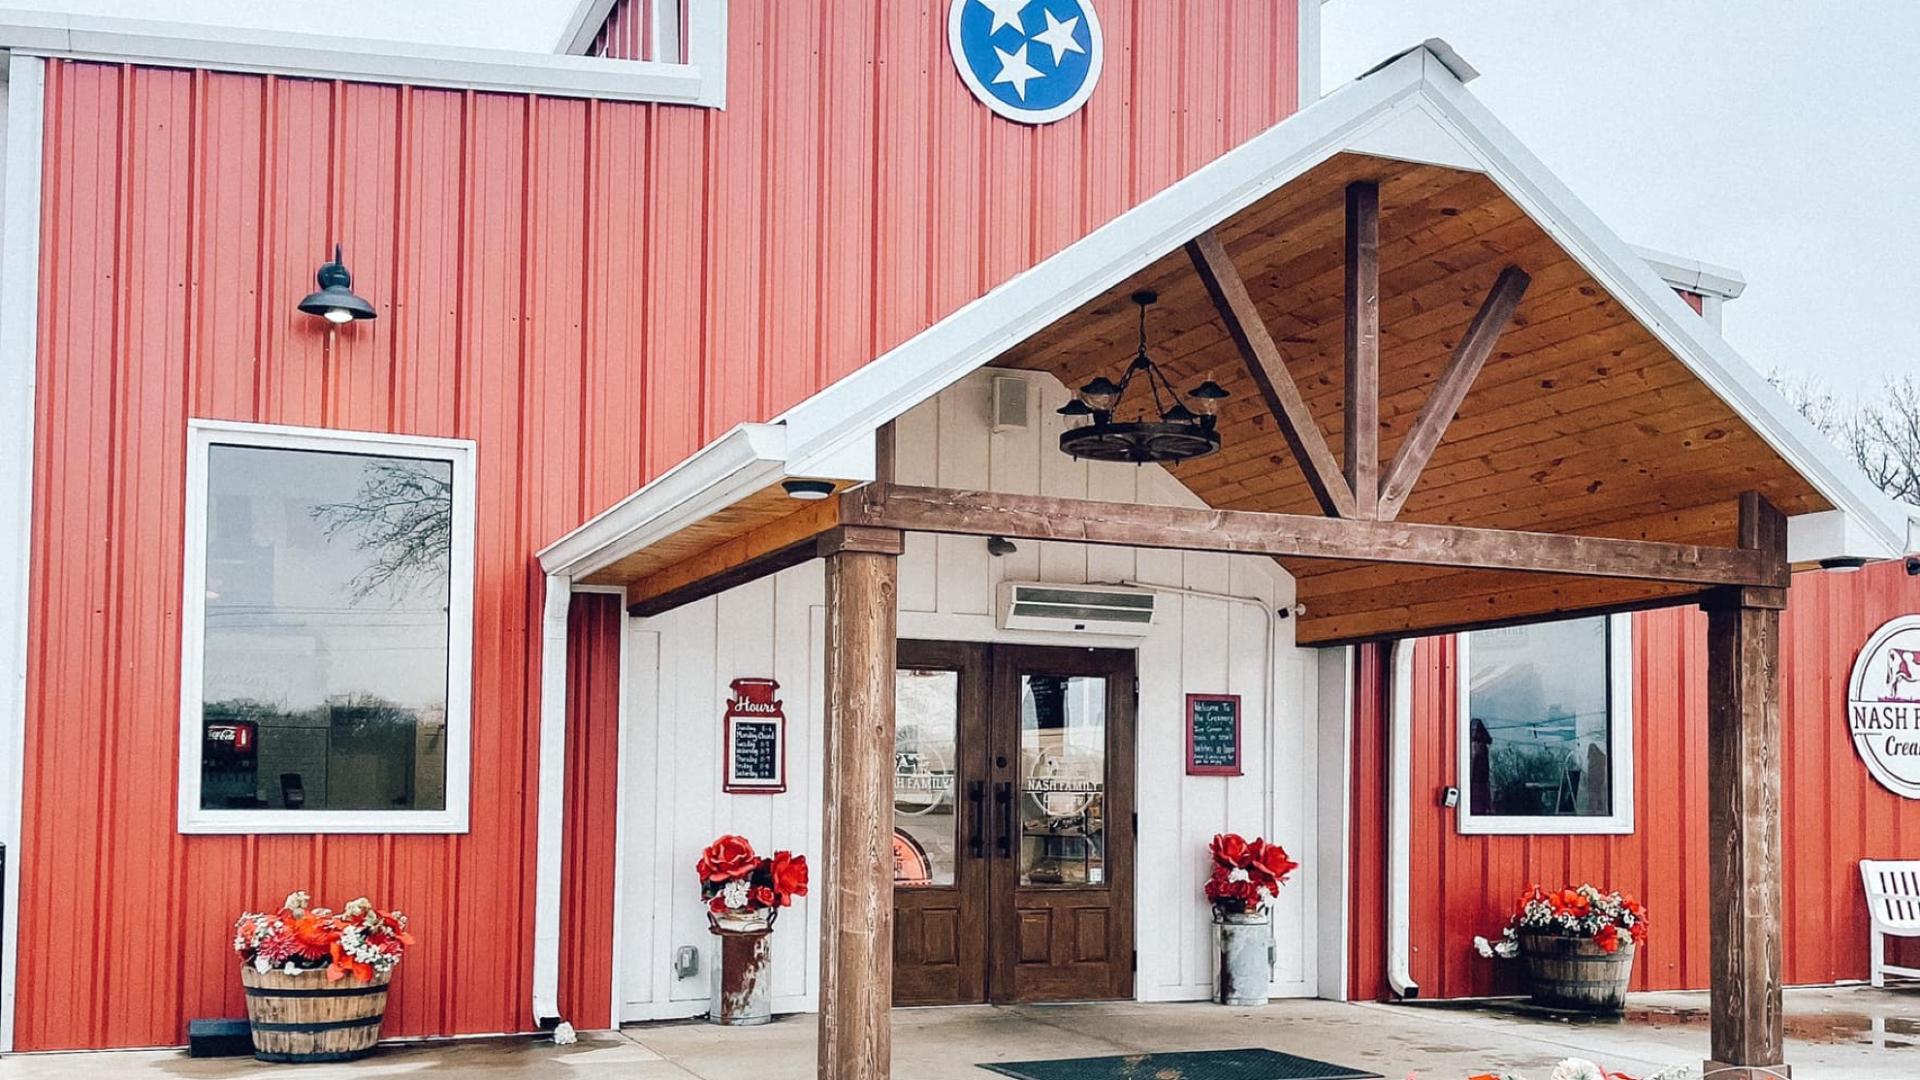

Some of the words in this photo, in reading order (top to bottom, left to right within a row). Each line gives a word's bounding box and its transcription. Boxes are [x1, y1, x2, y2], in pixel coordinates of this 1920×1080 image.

[735, 695, 776, 713] Hours
[1853, 706, 1908, 730] NASH
[736, 730, 758, 742] Monday
[907, 777, 955, 789] FAMILY
[1028, 779, 1057, 791] NASH
[1059, 780, 1099, 792] FAMILY
